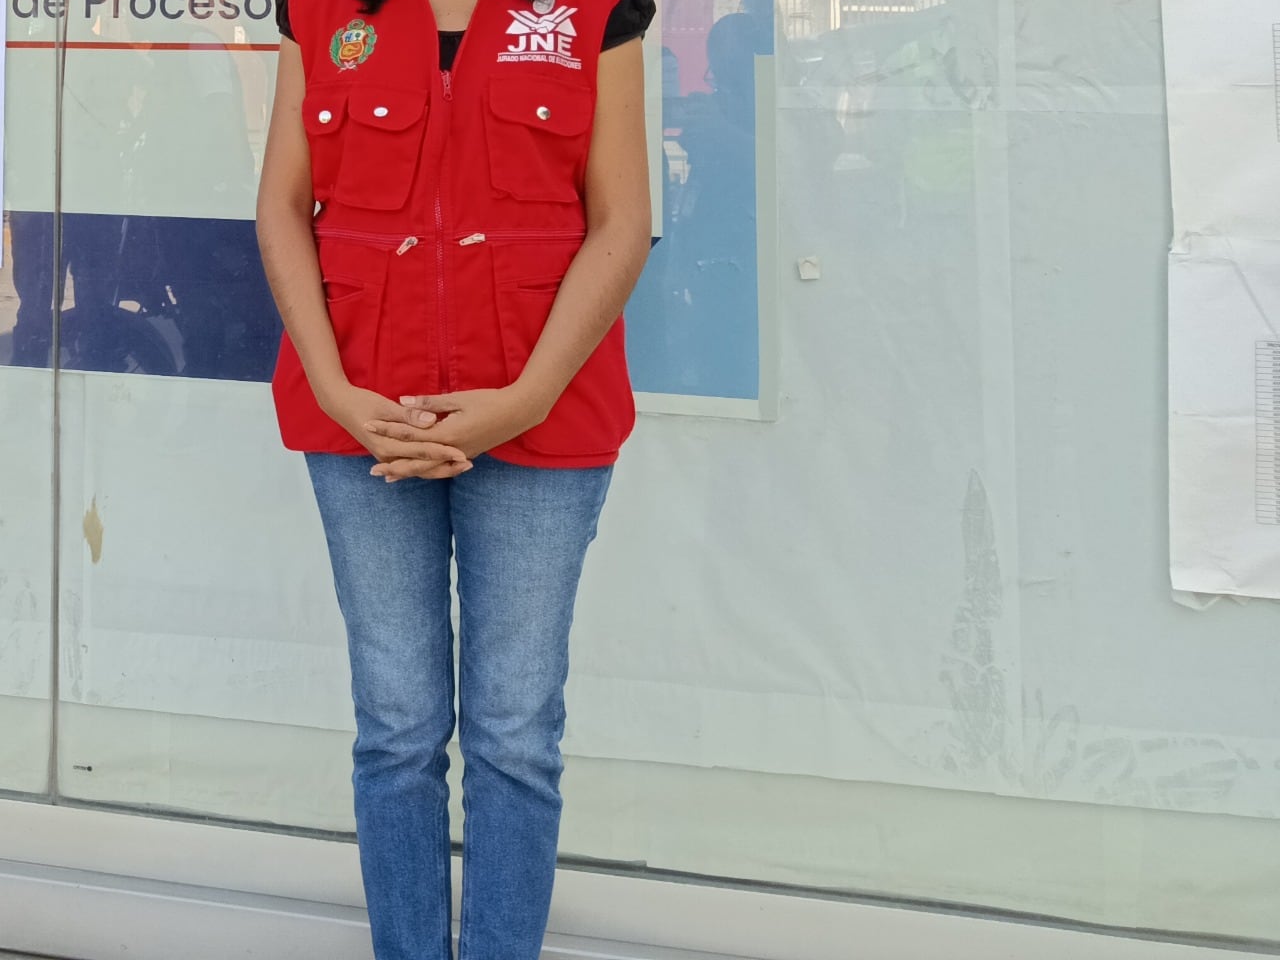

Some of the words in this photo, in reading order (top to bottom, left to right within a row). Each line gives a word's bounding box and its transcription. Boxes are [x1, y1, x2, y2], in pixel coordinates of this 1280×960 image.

[508, 34, 574, 56] JNE
[497, 53, 519, 62] JURADO
[520, 54, 548, 62] NACIONAL
